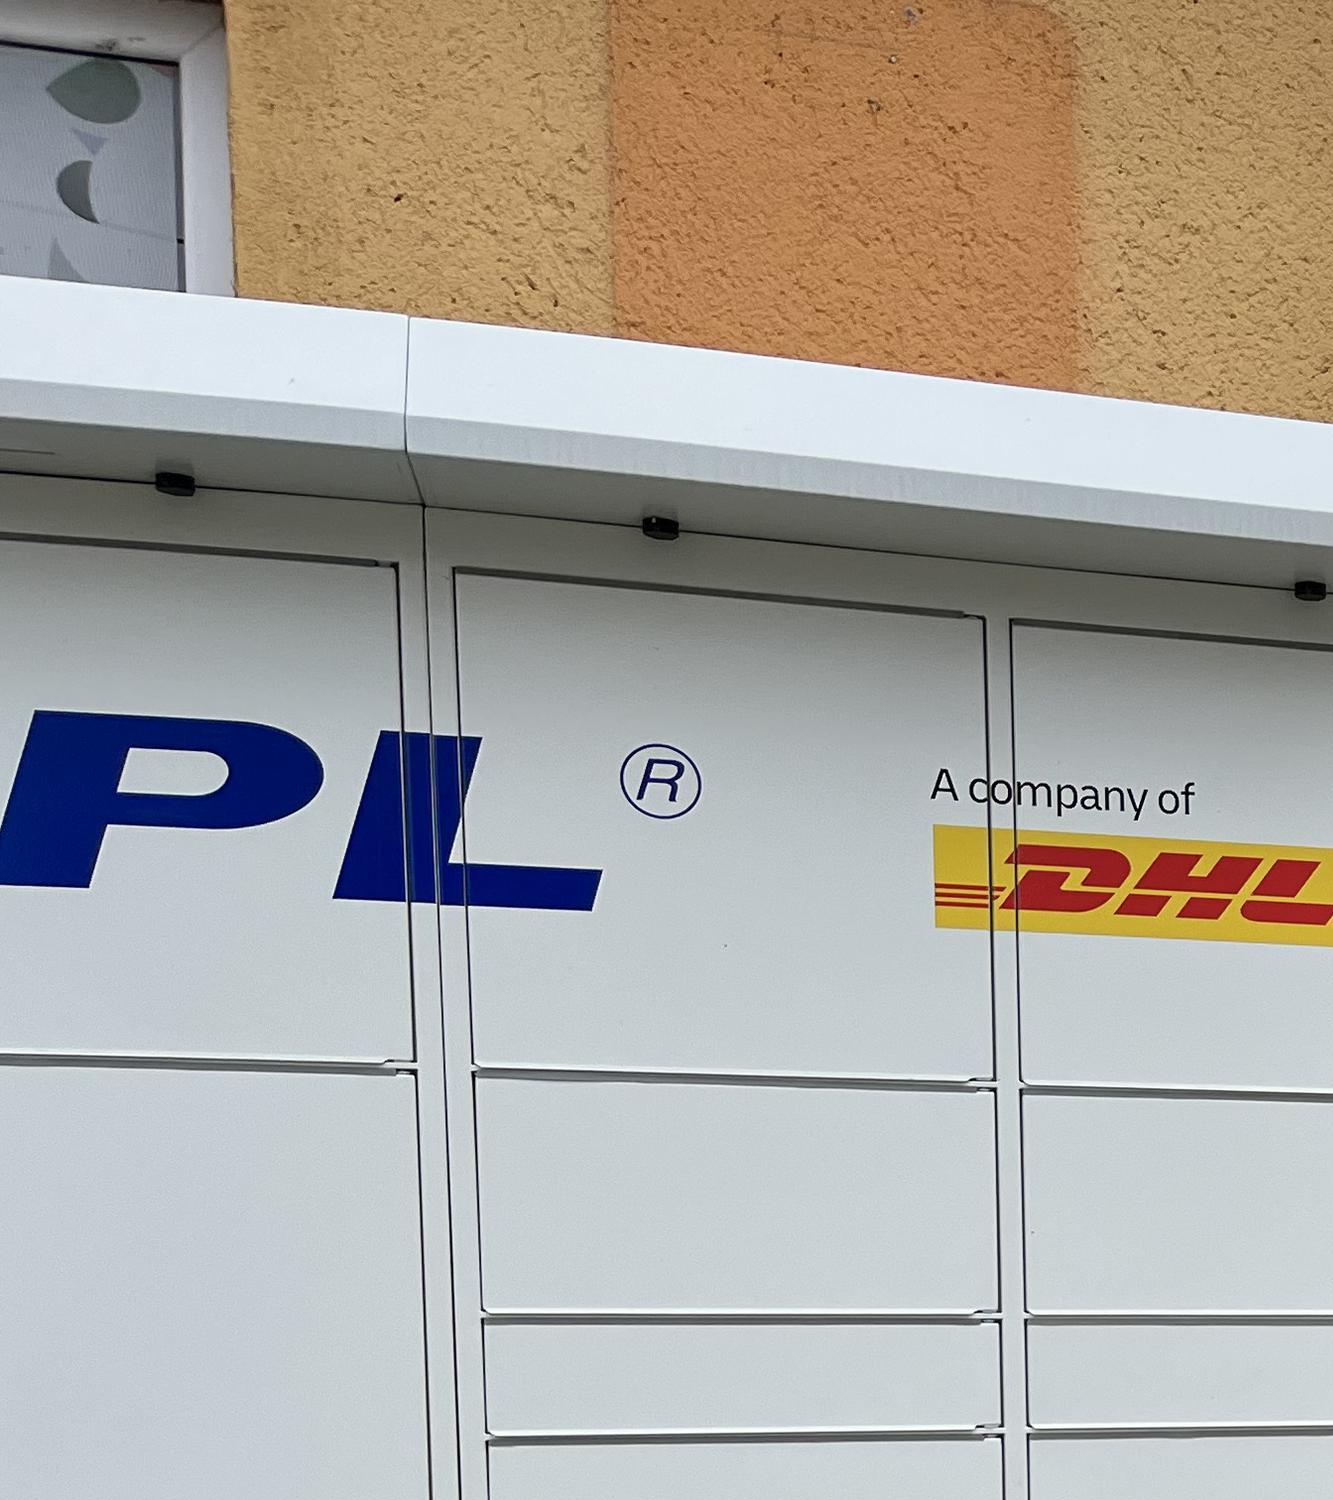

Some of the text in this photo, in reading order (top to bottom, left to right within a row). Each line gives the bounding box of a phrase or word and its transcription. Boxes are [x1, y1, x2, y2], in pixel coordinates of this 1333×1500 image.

[929, 767, 1196, 821] A company of
